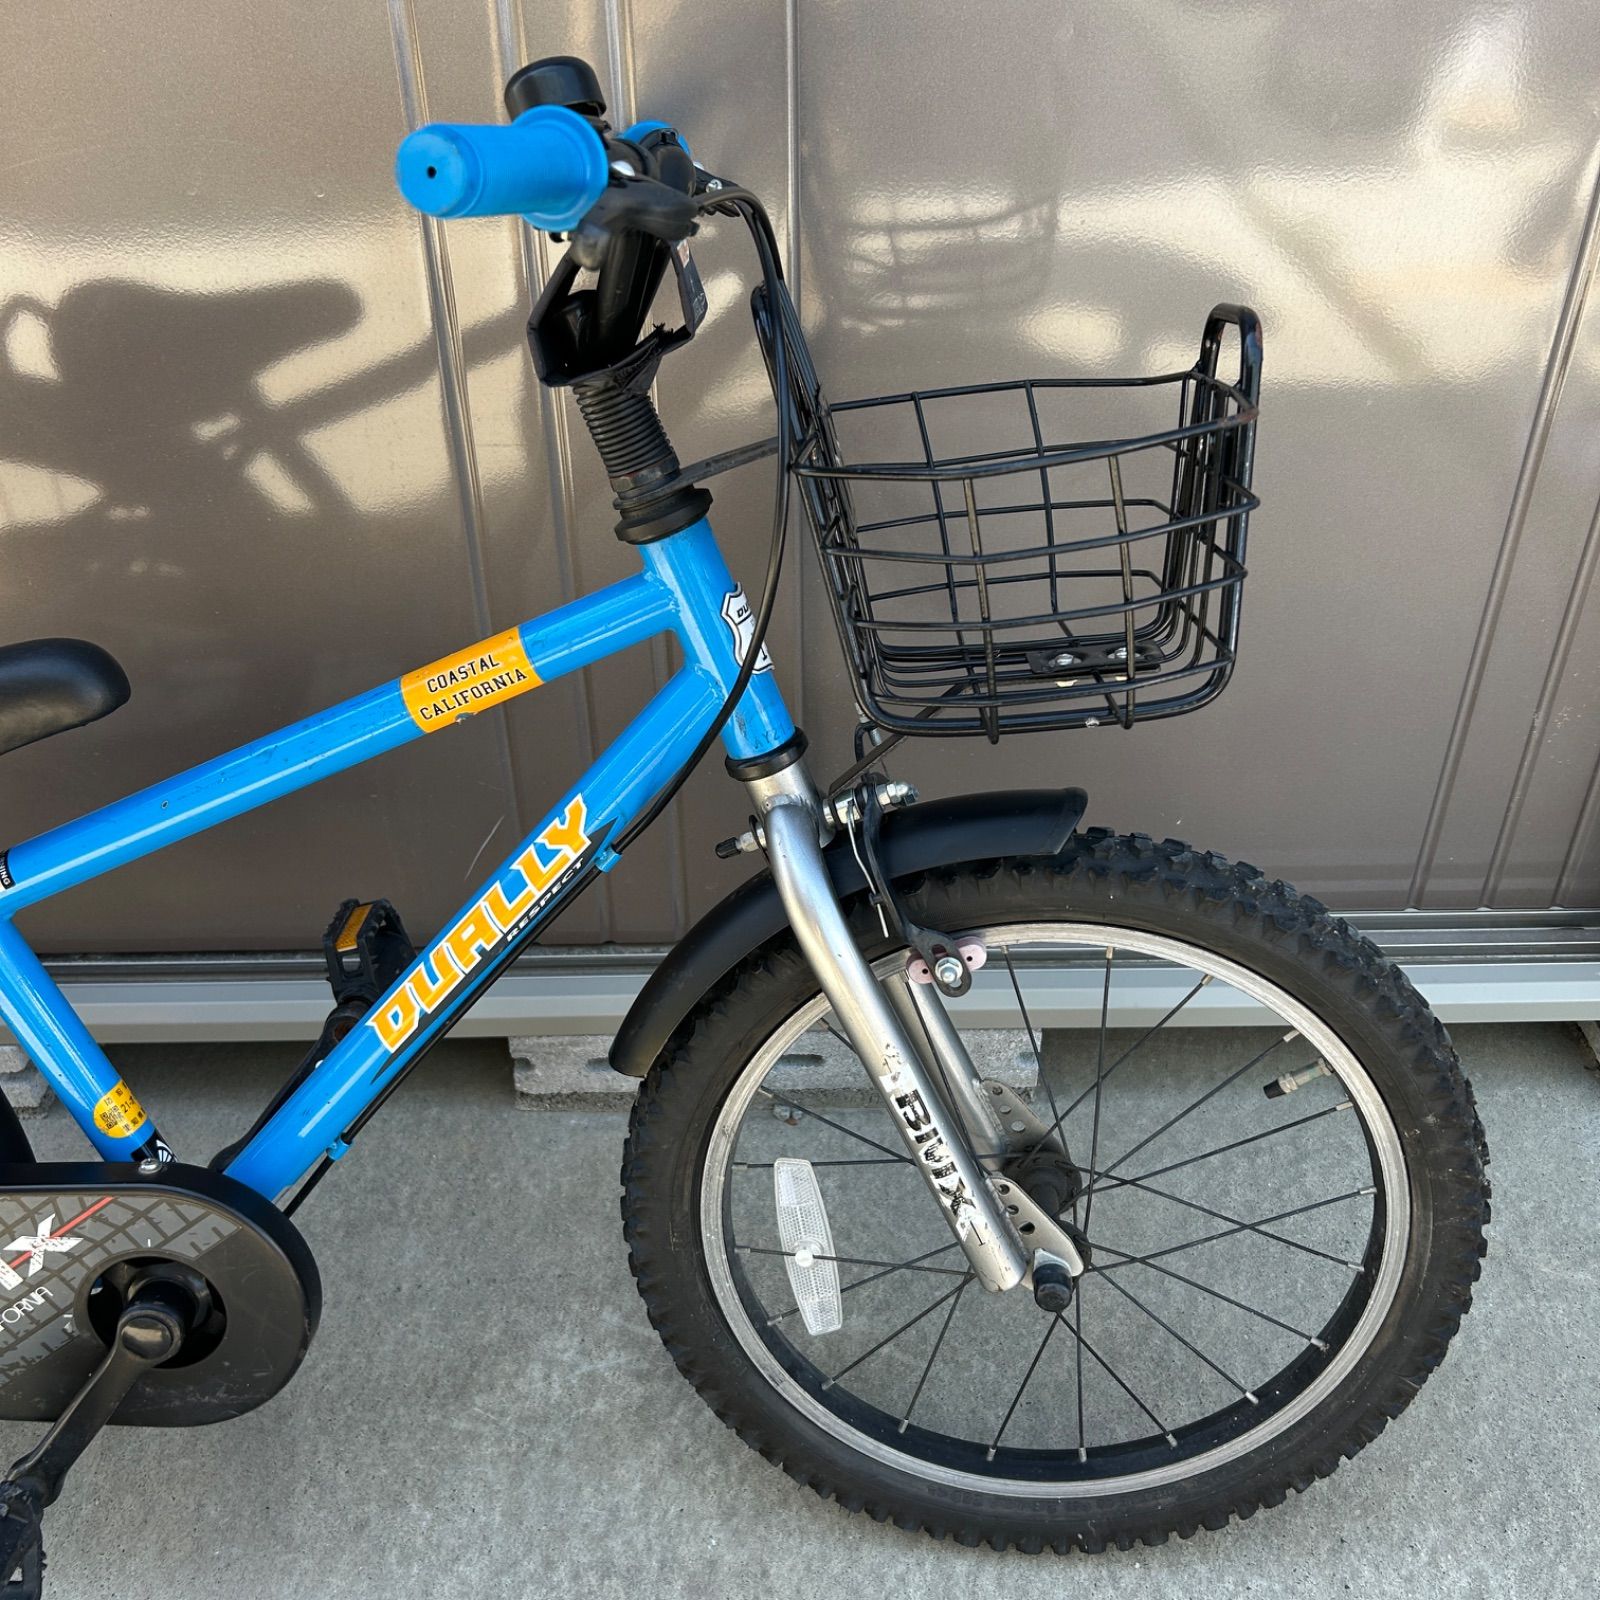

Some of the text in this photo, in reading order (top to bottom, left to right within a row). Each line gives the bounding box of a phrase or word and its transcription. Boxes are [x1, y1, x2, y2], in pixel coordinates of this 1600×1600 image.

[419, 668, 527, 720] CALIFORNIA
[427, 654, 500, 693] COASTAL
[365, 793, 592, 1054] DUALLY
[506, 857, 584, 942] RESPECT
